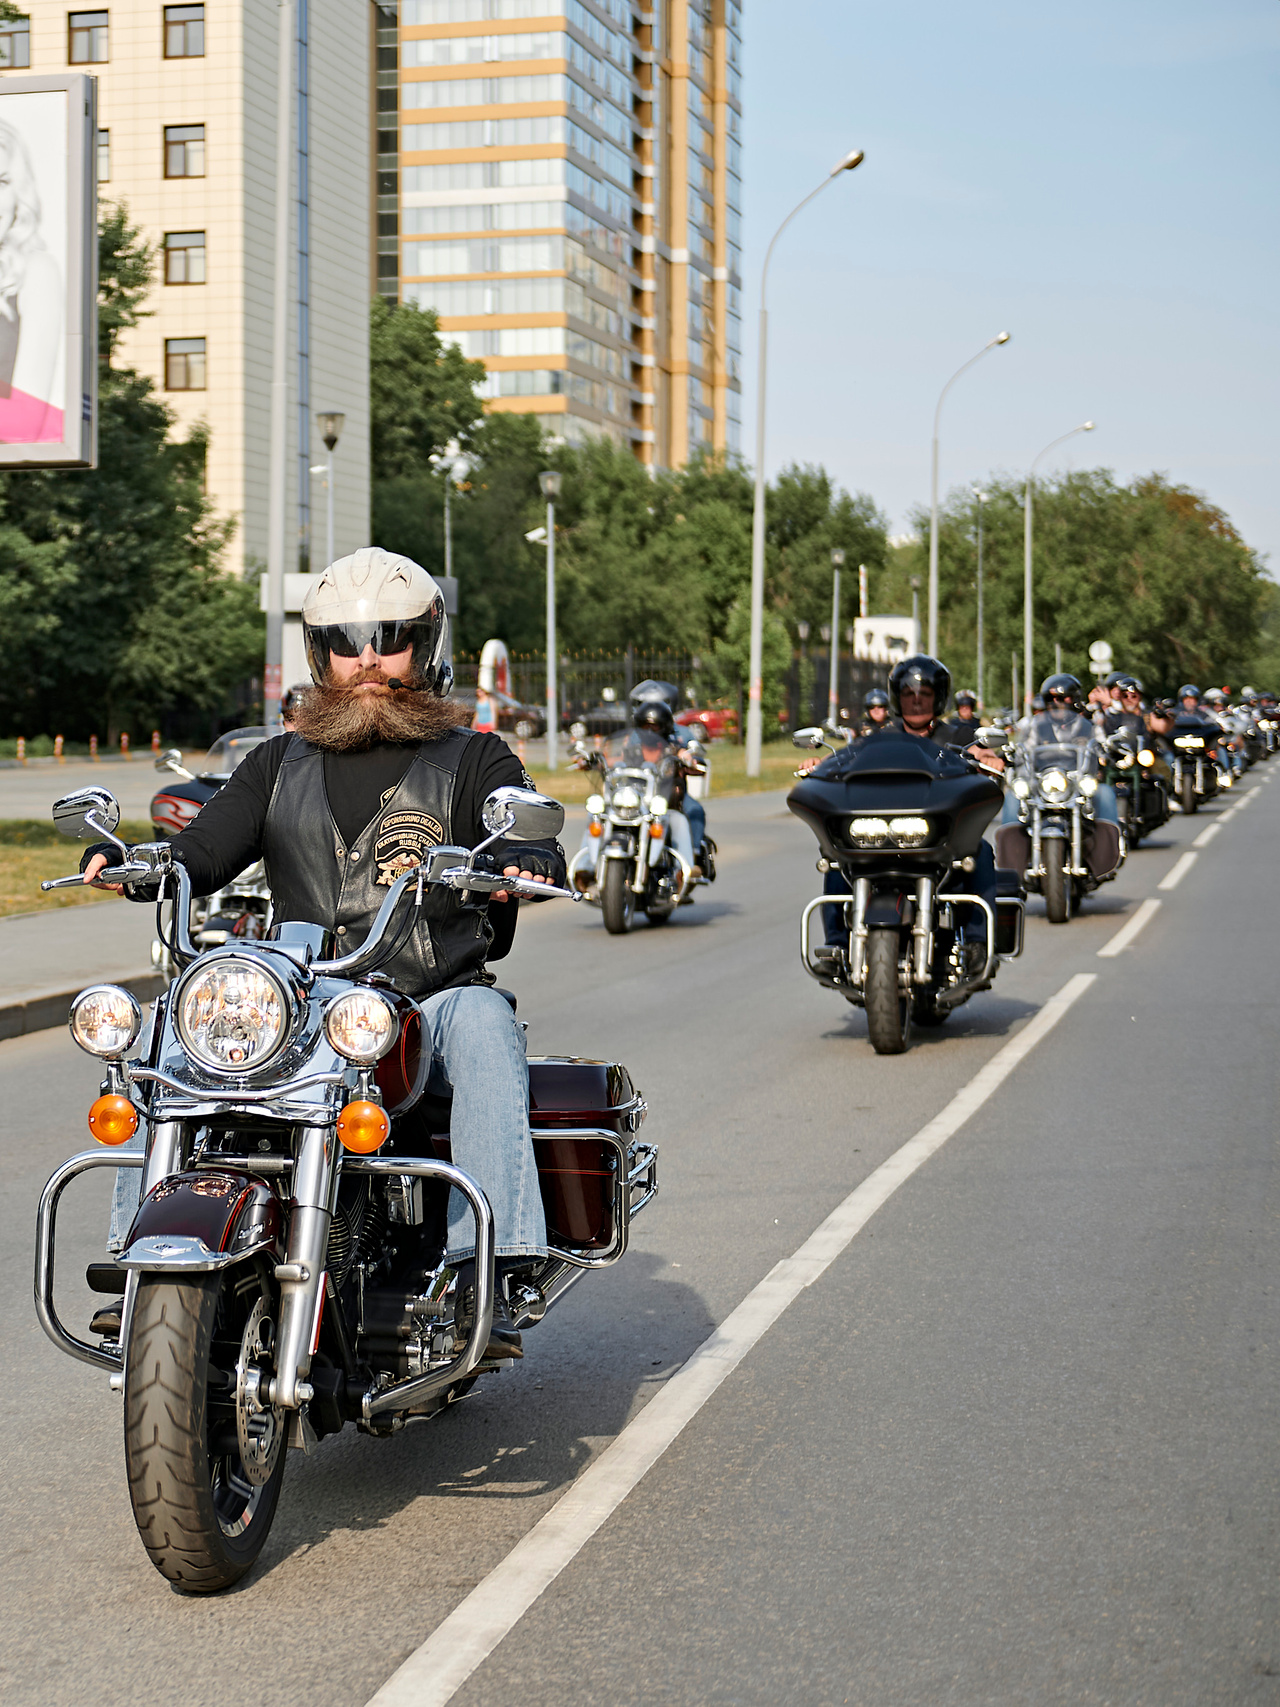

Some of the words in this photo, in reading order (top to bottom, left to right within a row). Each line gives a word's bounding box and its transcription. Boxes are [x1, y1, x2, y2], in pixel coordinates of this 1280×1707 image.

[383, 815, 421, 828] SPONSORING
[420, 818, 441, 834] DEALER
[398, 839, 422, 849] RUSSIA
